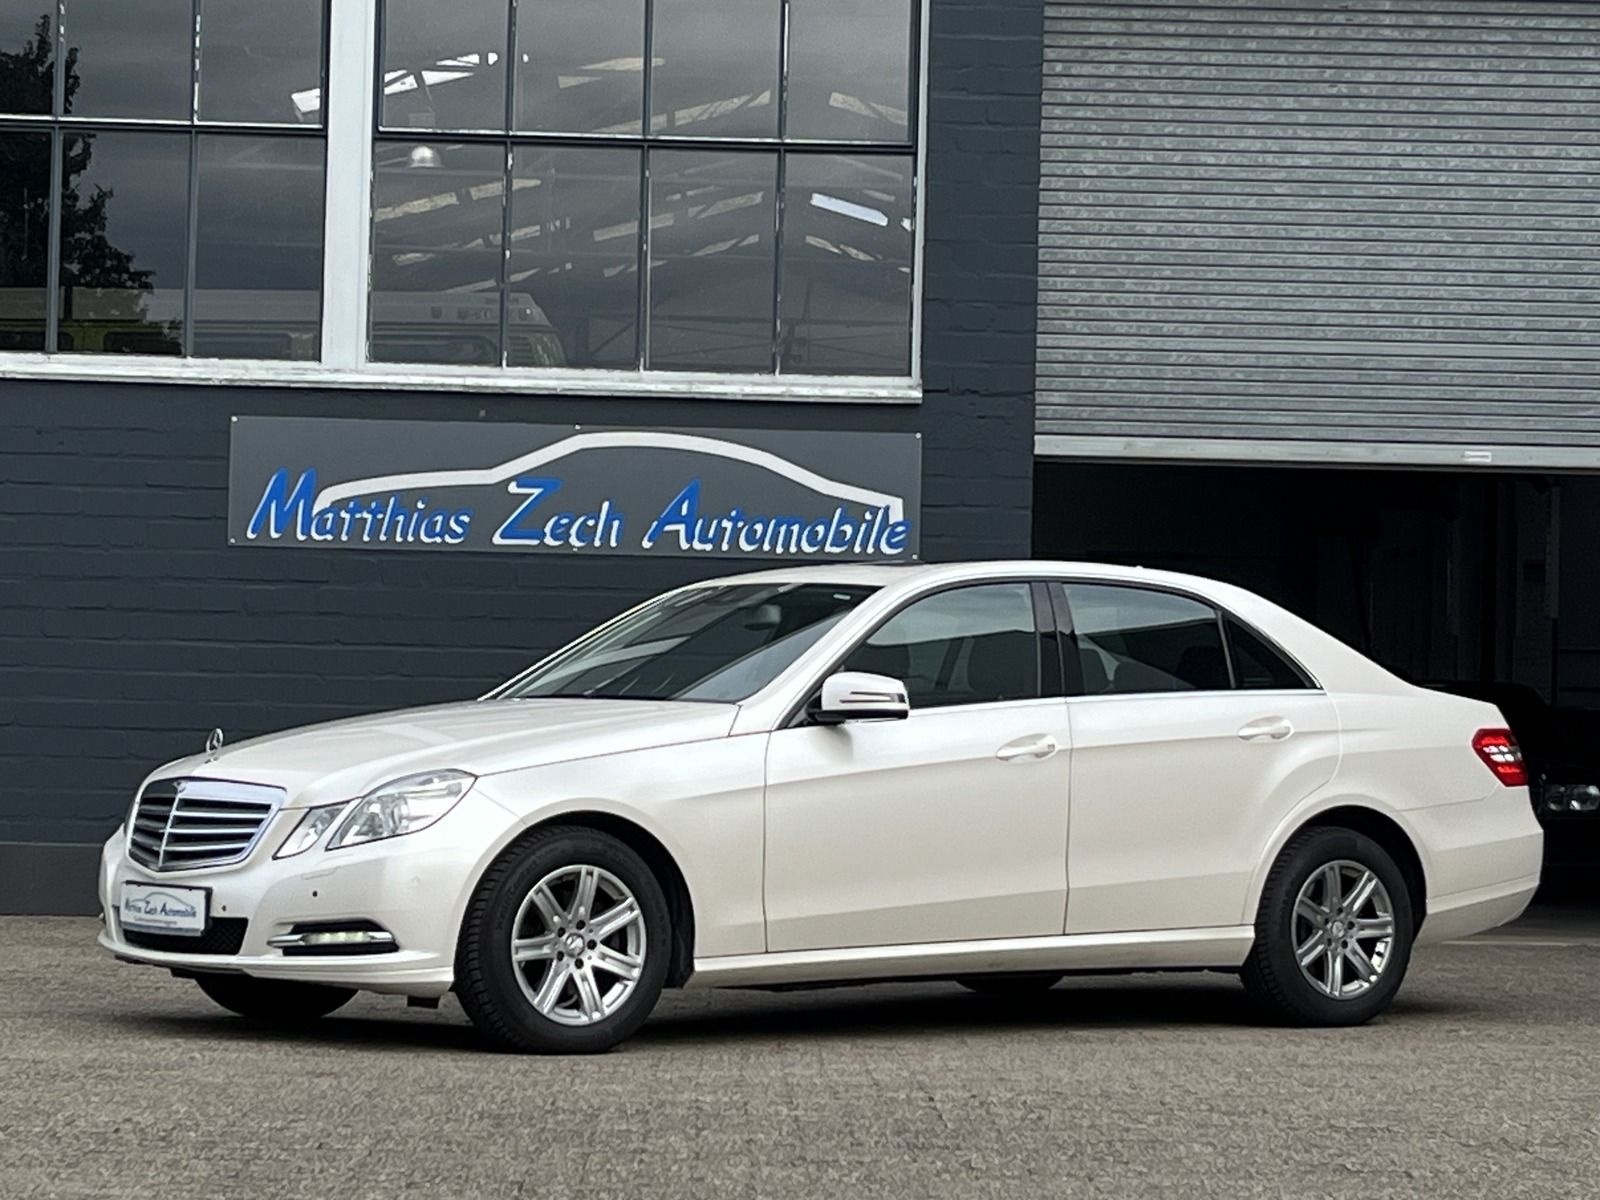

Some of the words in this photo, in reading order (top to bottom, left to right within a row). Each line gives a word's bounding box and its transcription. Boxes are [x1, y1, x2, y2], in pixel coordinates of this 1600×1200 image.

[246, 467, 473, 544] Matthias
[491, 476, 624, 547] Zech
[640, 478, 911, 556] Automobile
